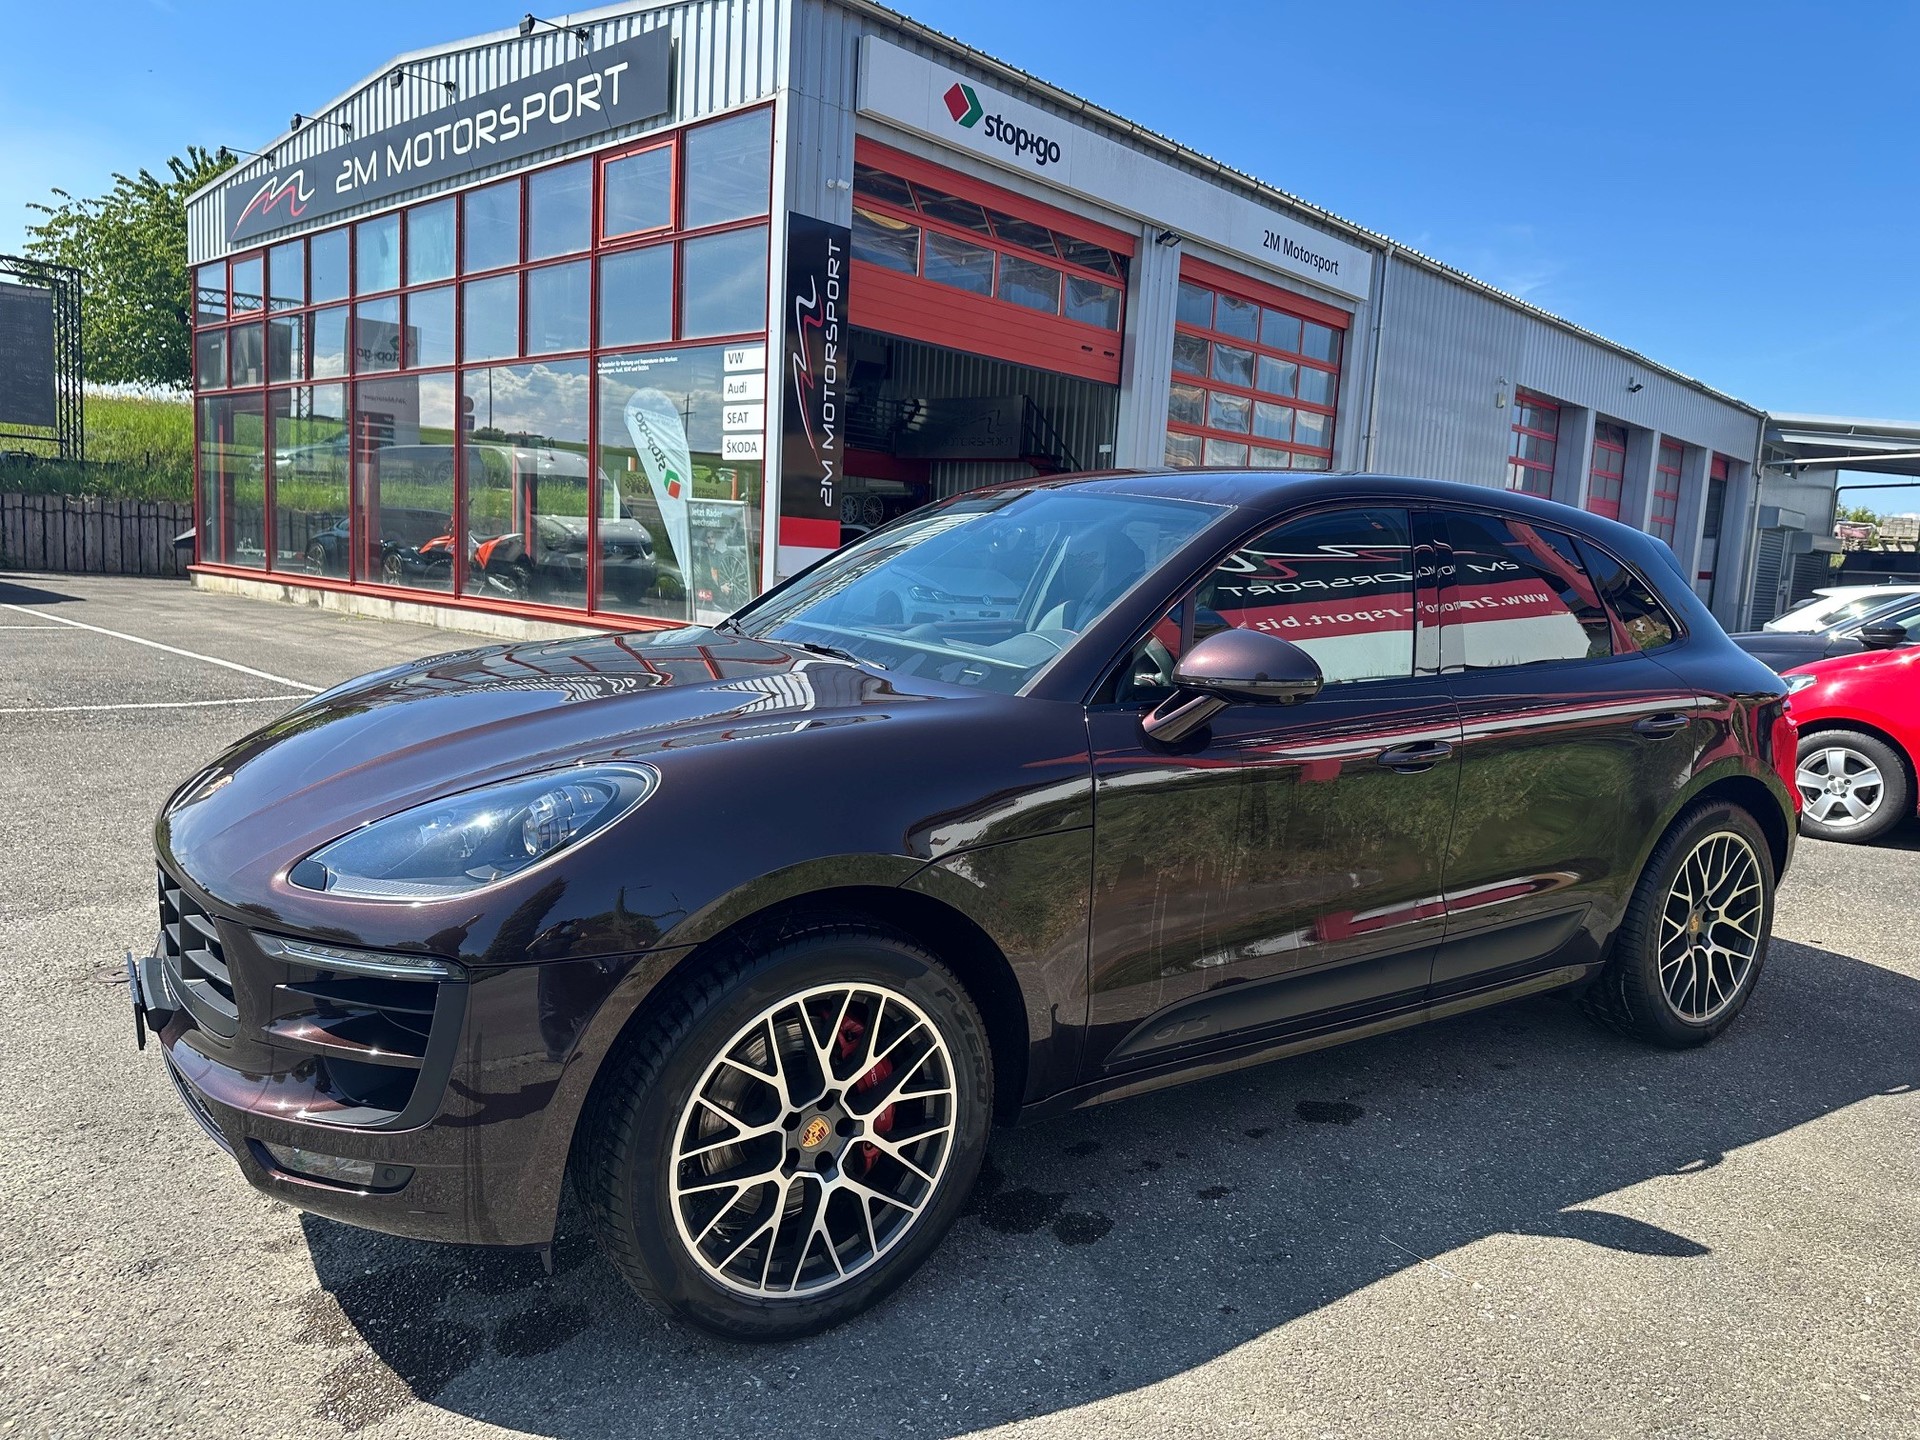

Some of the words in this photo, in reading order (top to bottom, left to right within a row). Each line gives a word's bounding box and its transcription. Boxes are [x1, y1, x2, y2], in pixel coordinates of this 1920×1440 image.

[336, 150, 377, 194] 2M
[387, 61, 629, 178] MOTORSPORT
[984, 114, 1061, 166] stop+go
[1263, 229, 1281, 252] 2M
[1283, 238, 1339, 276] Motorsport
[728, 351, 745, 365] VW
[821, 238, 841, 450] MOTORSPORT
[727, 381, 748, 394] Audi
[727, 411, 749, 425] SEAT
[726, 440, 758, 454] ŠKODA
[820, 460, 833, 507] 2M
[705, 507, 723, 518] Räder
[1152, 1014, 1212, 1042] GTS
